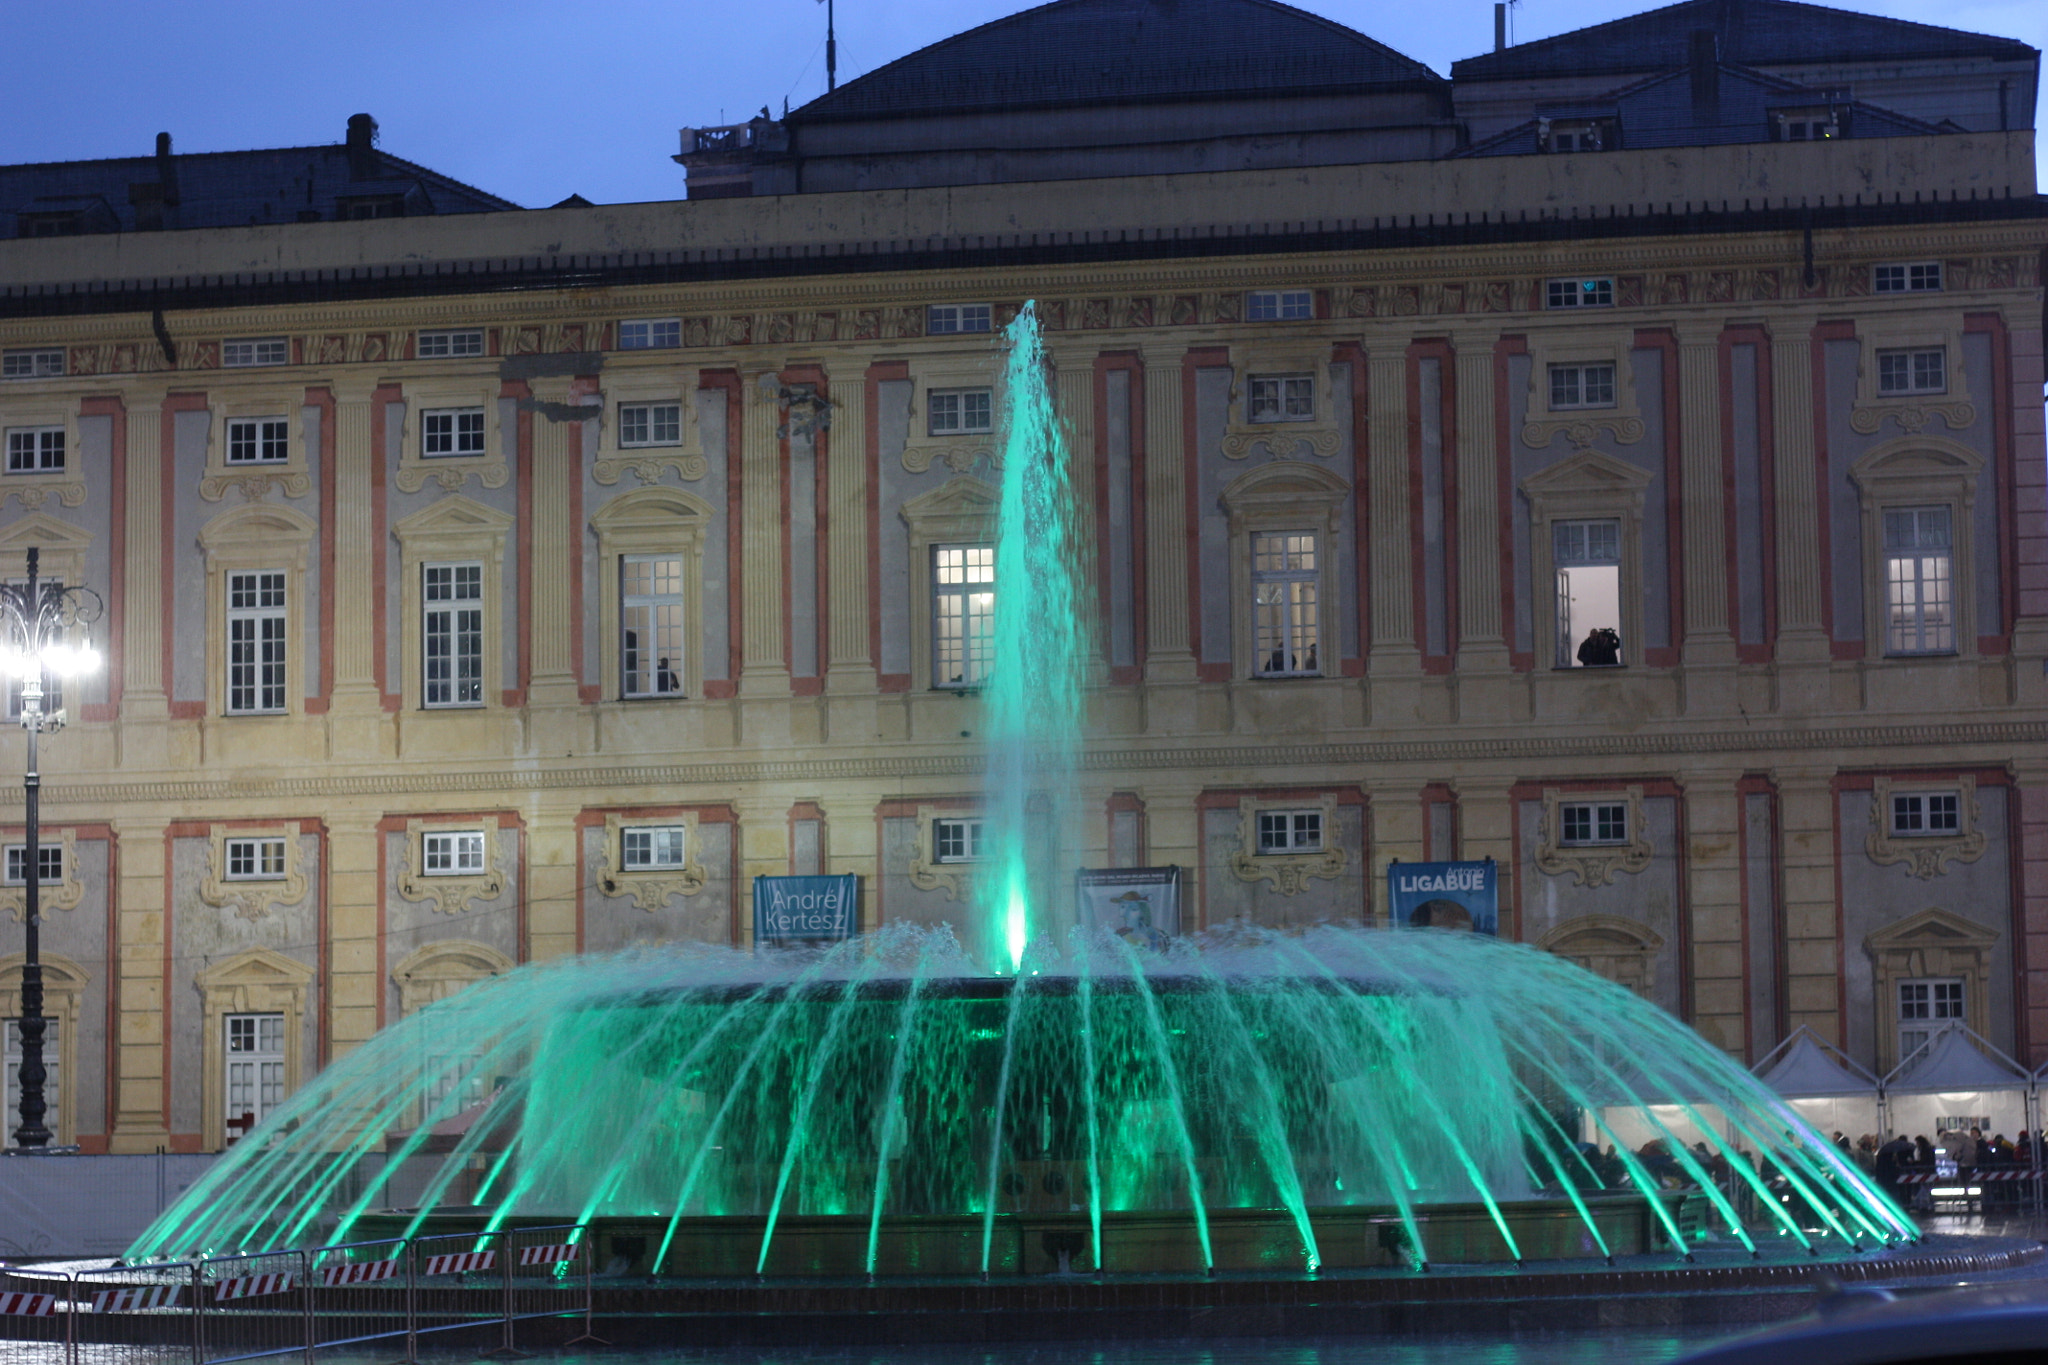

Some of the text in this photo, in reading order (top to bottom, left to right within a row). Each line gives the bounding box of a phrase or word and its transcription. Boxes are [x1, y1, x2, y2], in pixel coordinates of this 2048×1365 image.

[1446, 866, 1485, 876] Antonio
[1400, 874, 1485, 892] LIGABUE
[771, 889, 837, 910] André
[766, 910, 845, 930] Kertész
